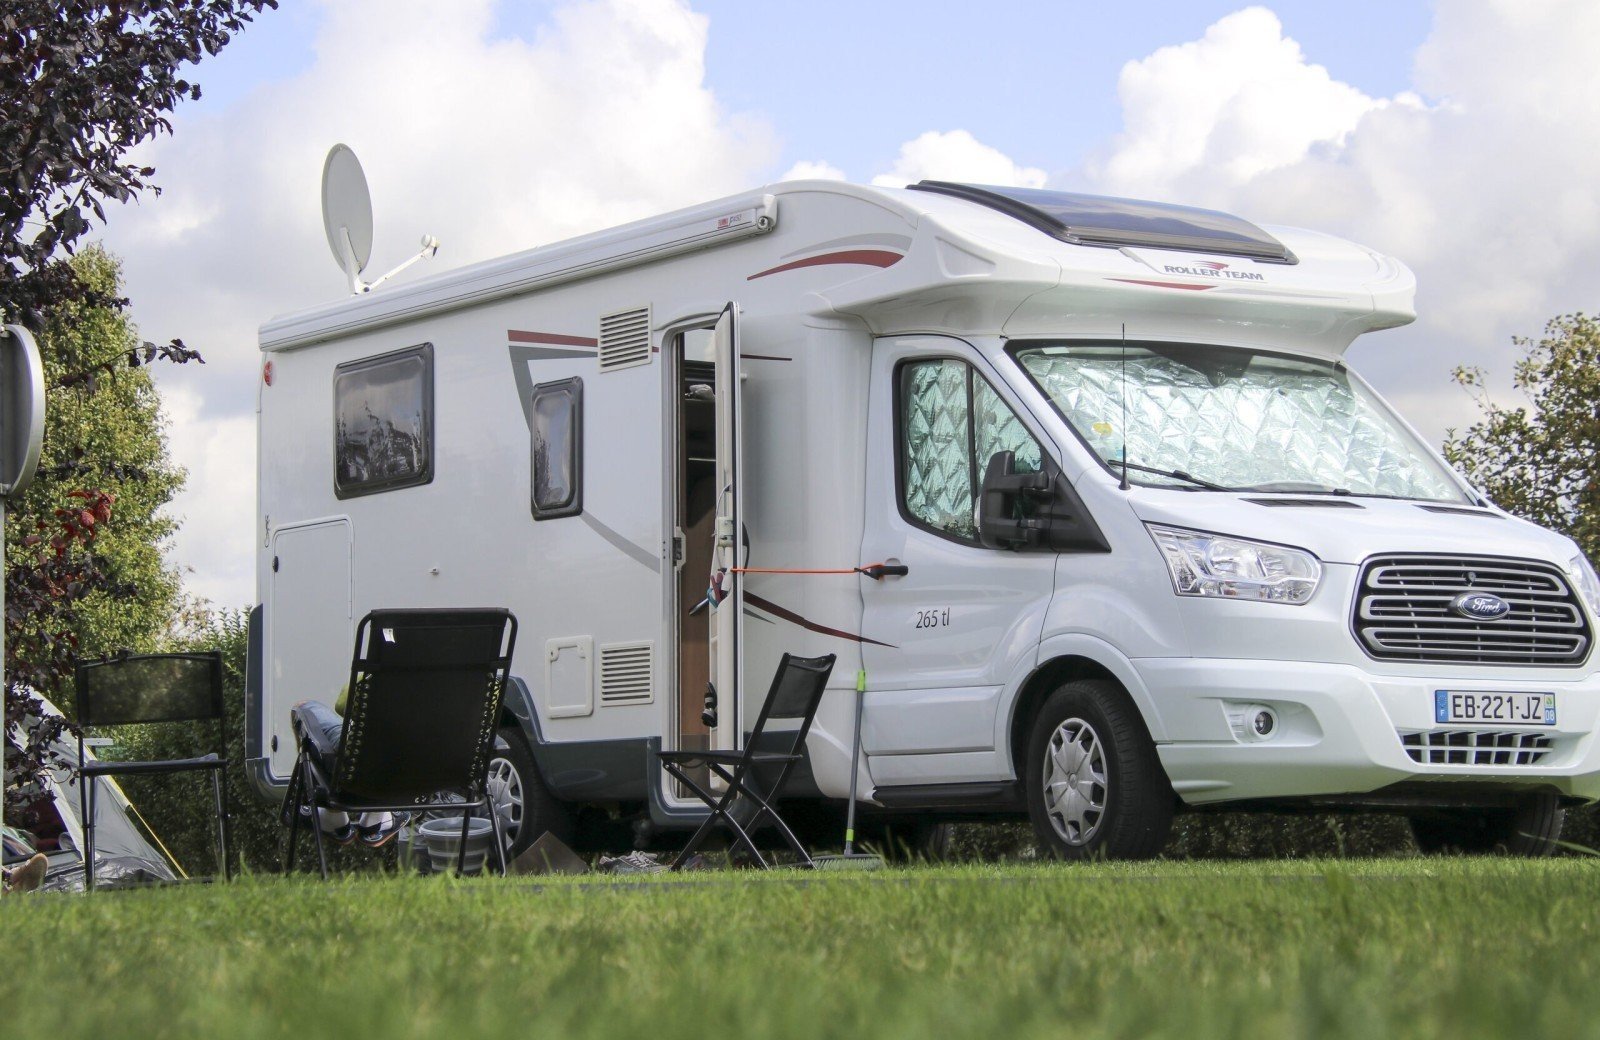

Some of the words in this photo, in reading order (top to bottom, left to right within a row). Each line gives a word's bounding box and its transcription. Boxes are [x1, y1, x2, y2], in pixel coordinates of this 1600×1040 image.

[1164, 265, 1220, 277] ROLLER
[1223, 270, 1264, 281] TEAM
[1472, 597, 1500, 612] Ford
[916, 610, 938, 628] 265
